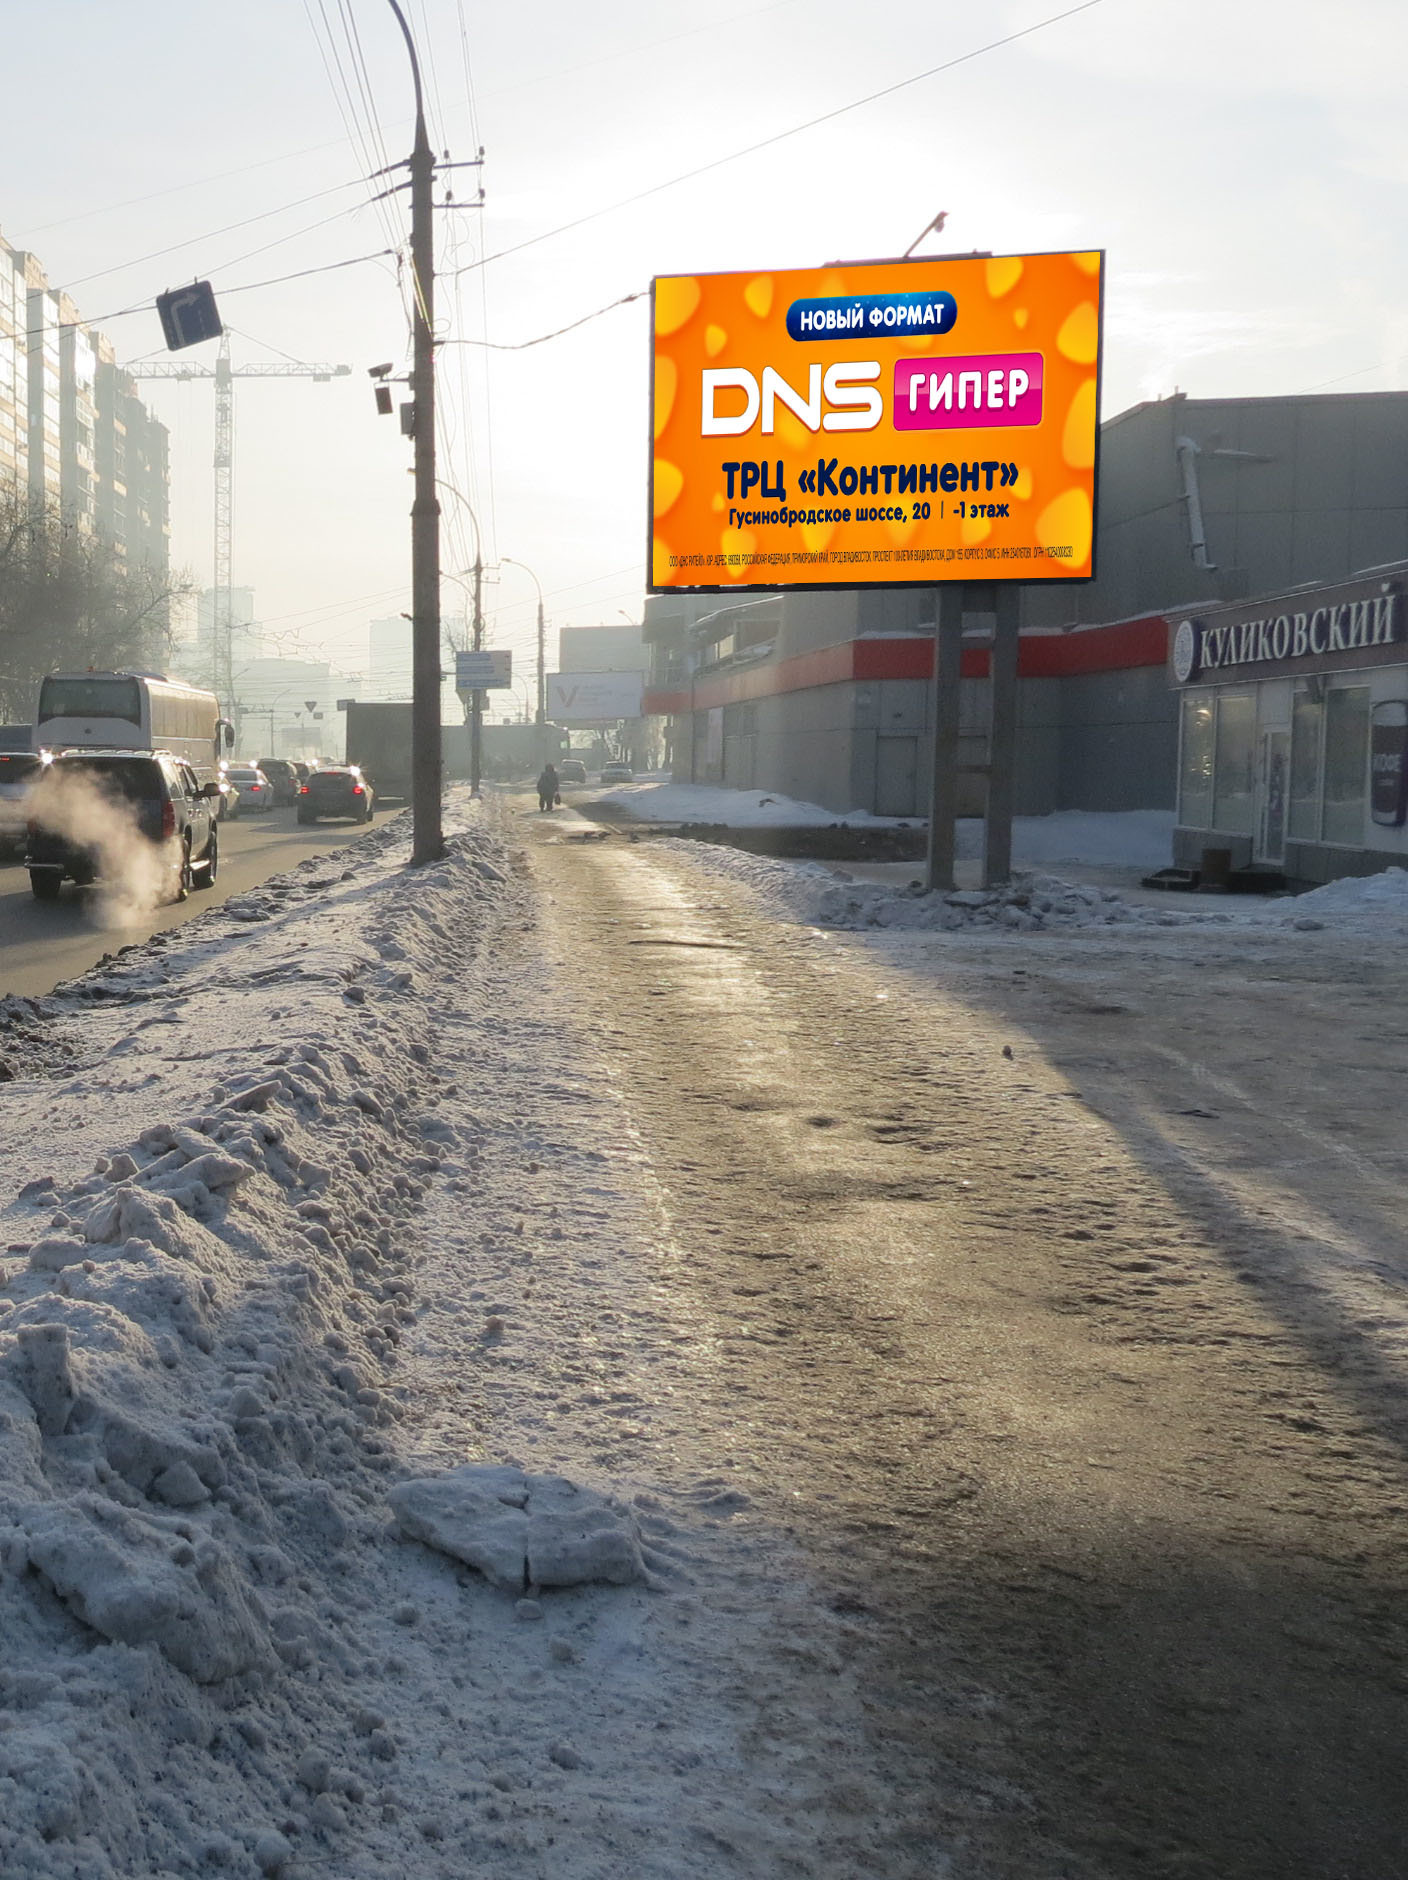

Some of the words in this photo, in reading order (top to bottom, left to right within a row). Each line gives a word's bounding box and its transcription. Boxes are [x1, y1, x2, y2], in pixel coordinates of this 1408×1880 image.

[800, 302, 864, 331] НОВЫЙ
[868, 303, 945, 328] ФОРМАТ
[701, 360, 884, 438] DNS
[908, 368, 1029, 413] ГИПЕР
[721, 459, 787, 502] ТРЦ
[798, 457, 1019, 497] «Континент»
[728, 506, 852, 530] Гусинобродское
[855, 505, 908, 524] шоссе,
[912, 502, 931, 520] 20
[953, 501, 966, 519] -1
[970, 502, 1010, 519] этаж
[1198, 582, 1396, 669] КУЛИКОВСКИЙ
